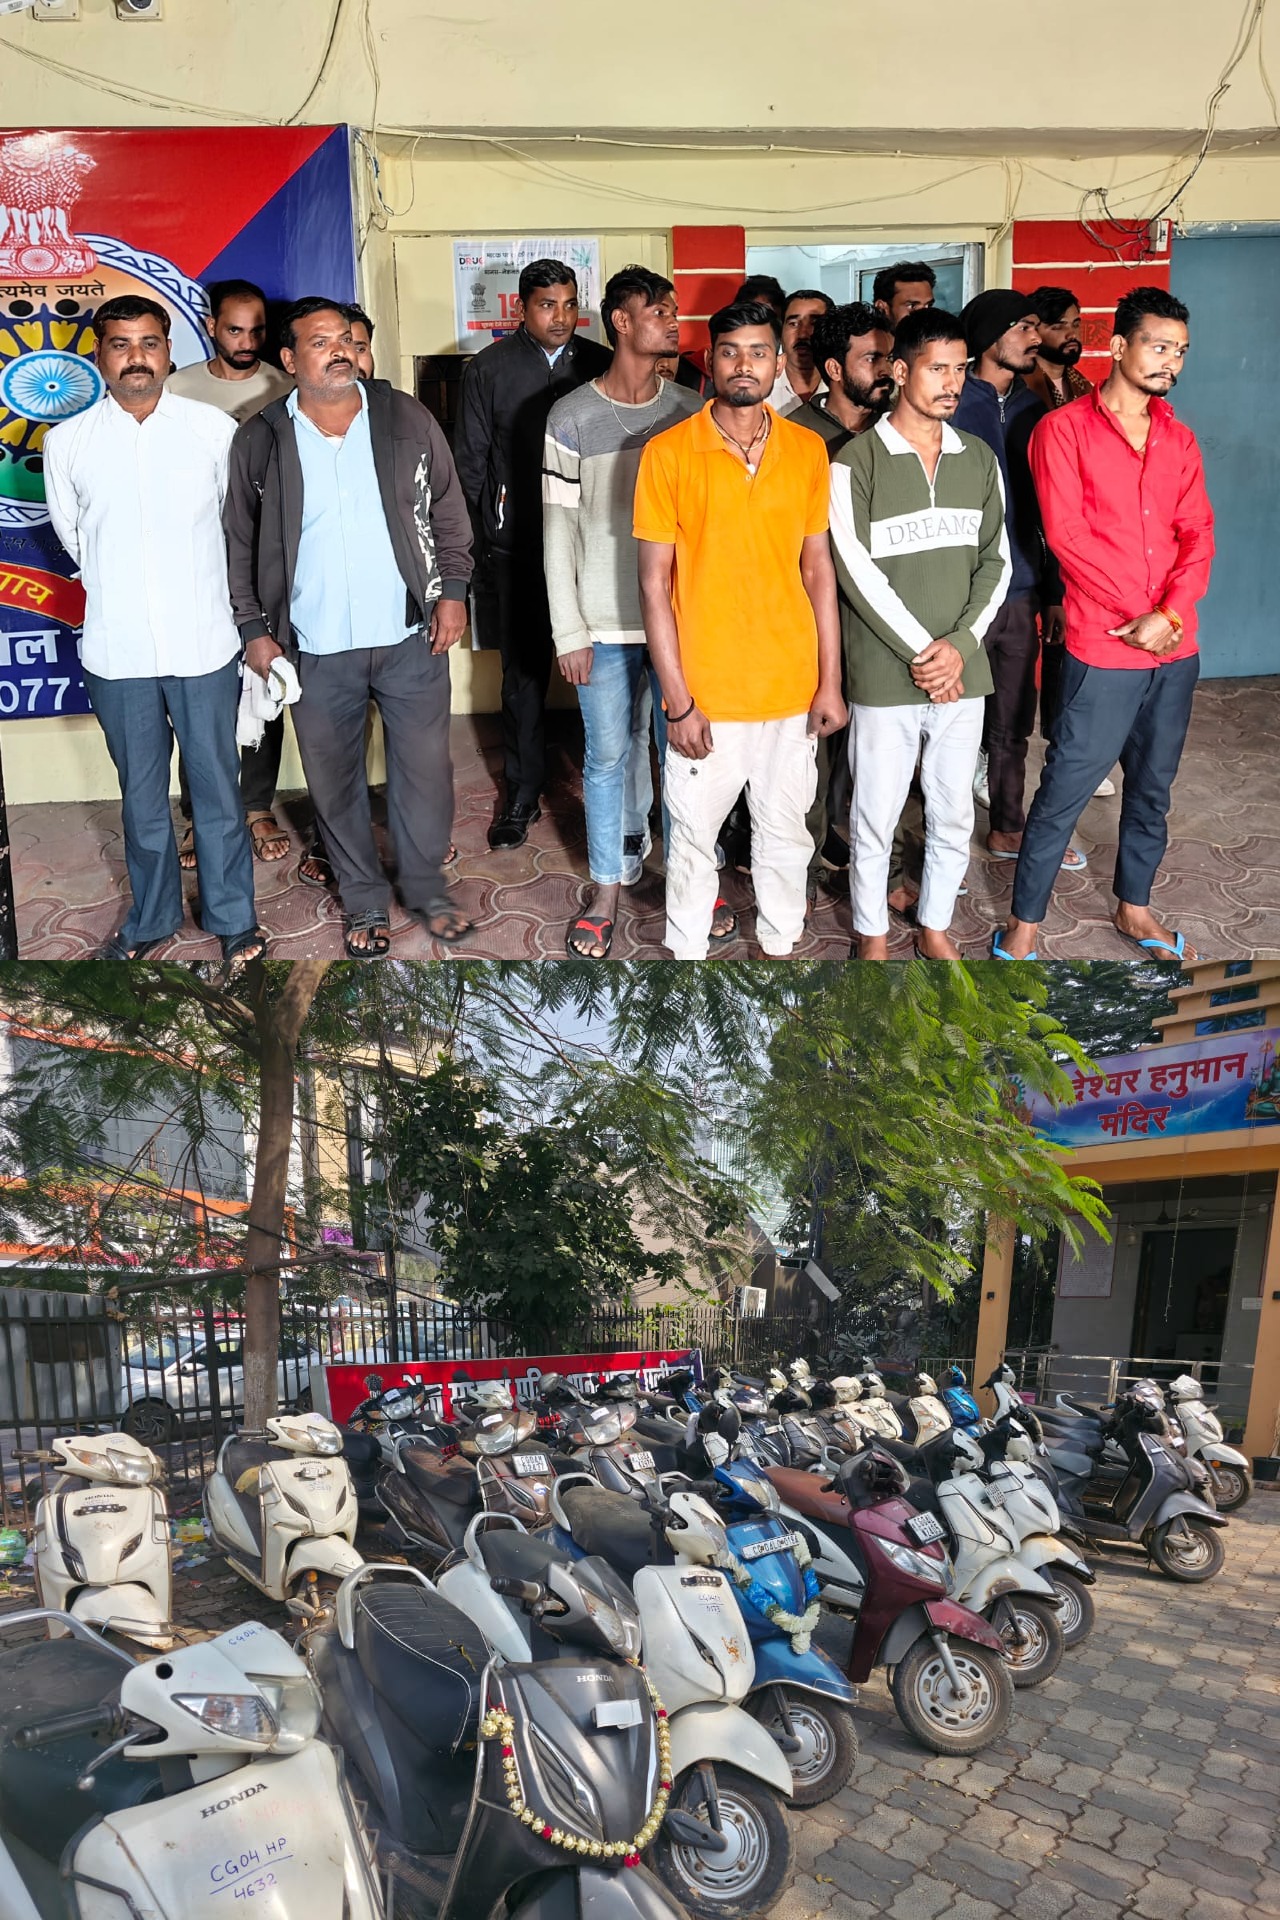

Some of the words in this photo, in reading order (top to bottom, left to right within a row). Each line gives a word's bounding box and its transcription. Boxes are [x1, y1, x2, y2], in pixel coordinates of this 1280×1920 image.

[55, 279, 106, 297] जयते
[886, 515, 979, 546] DREAMS
[0, 677, 93, 714] 077
[1147, 1052, 1249, 1099] हनुमान
[1098, 1101, 1171, 1137] मंदिर
[576, 1674, 614, 1682] HONDA
[200, 1782, 269, 1819] HONDA
[210, 1849, 260, 1882] CG04
[265, 1837, 288, 1855] HP
[234, 1872, 278, 1899] 4632
